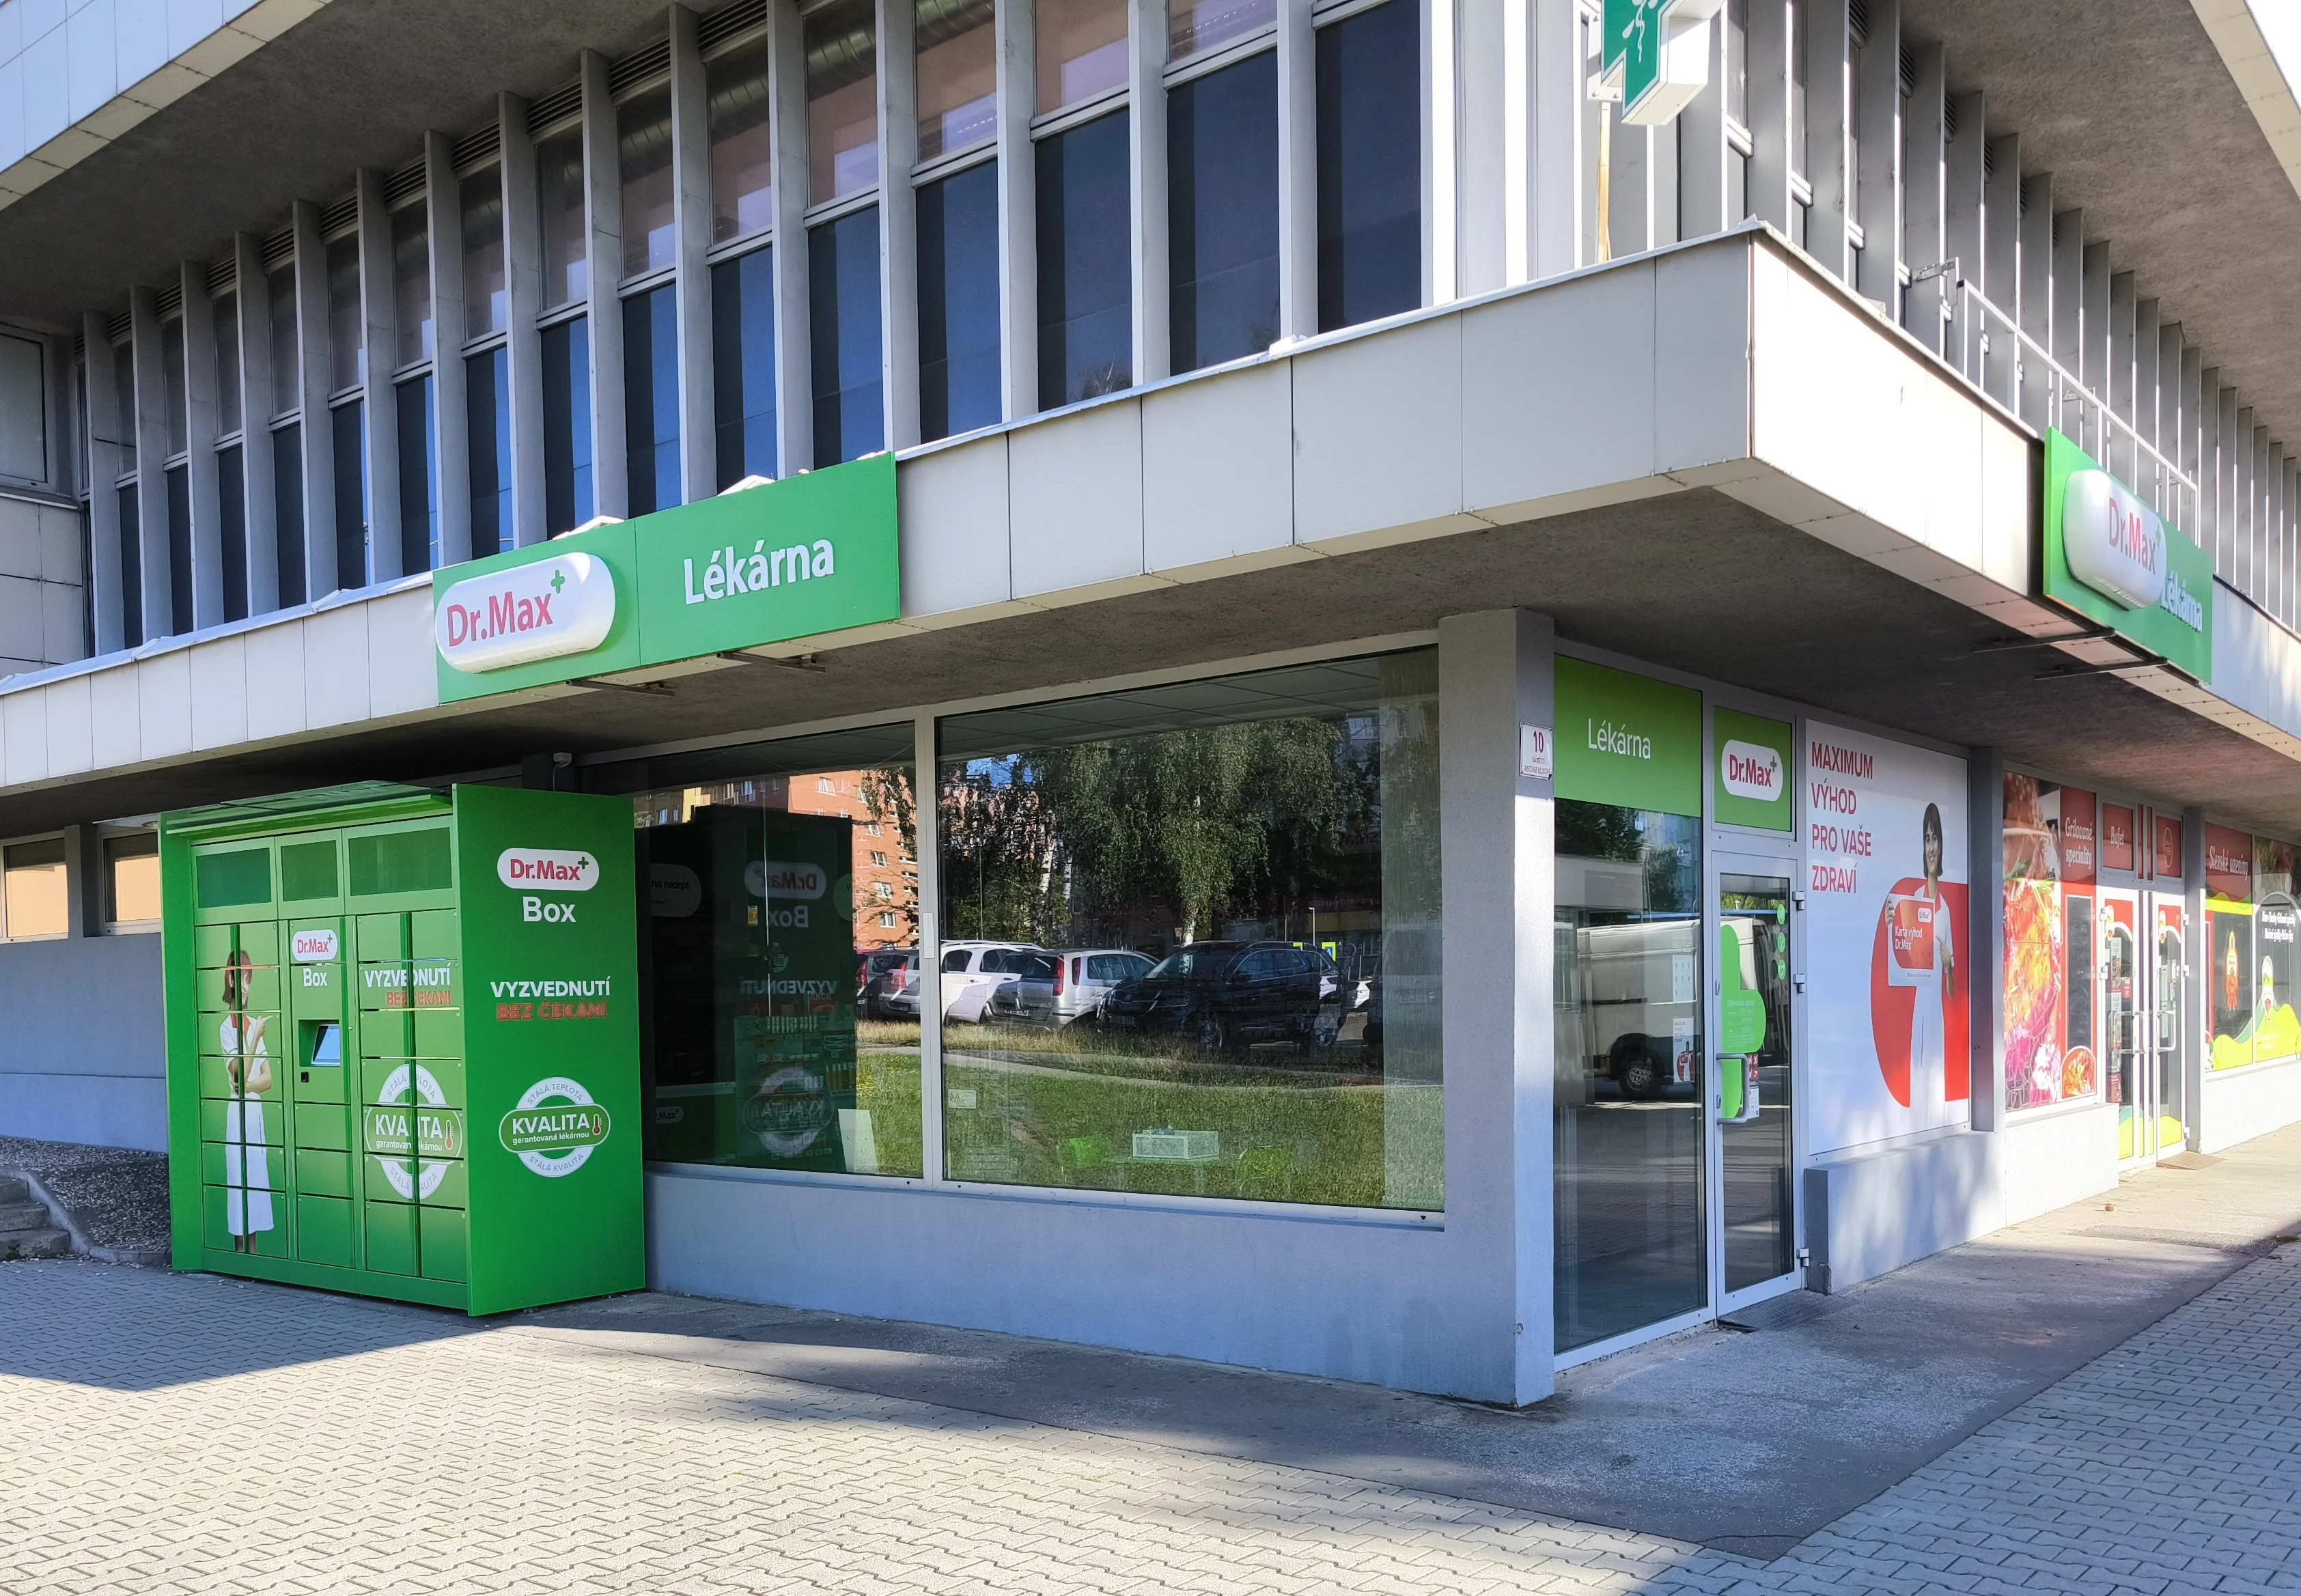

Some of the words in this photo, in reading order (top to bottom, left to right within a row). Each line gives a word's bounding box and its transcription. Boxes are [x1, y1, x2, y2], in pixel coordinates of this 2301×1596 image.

[683, 538, 835, 605] Lékárna
[2160, 570, 2203, 633] Lékárna
[1533, 730, 1544, 753] 10
[1588, 718, 1651, 759] Lékárna
[1811, 741, 1873, 780] MAXIMUM
[1811, 778, 1856, 815] VÝHOD
[1812, 824, 1838, 852] PRO
[1841, 824, 1871, 856] VAŠE
[2065, 817, 2093, 841] Grilované
[2065, 845, 2093, 869] speciality
[664, 880, 690, 891] recept
[1812, 863, 1857, 894] ZDRAVÍ
[522, 895, 576, 923] Box
[303, 968, 328, 987] Box
[490, 975, 611, 998] VYZVEDNUTÍ
[415, 986, 451, 1006] EKÁNÍ
[497, 1003, 533, 1021] BEZ
[538, 998, 607, 1020] ČEKÁNÍ
[387, 1072, 407, 1097] STÁLÁ
[527, 1084, 550, 1105] STÁLÁ
[551, 1083, 583, 1102] TEPLOTA
[376, 1114, 443, 1139] KVAITA
[512, 1112, 591, 1135] KVALITA
[376, 1140, 412, 1150] garantovan
[418, 1140, 443, 1151] kárnou
[512, 1133, 558, 1146] garantovaná
[559, 1131, 590, 1140] lékárnou
[529, 1156, 552, 1172] STÁLÁ
[553, 1153, 585, 1172] KVALITA
[390, 1166, 410, 1191] STÁLÁ
[420, 1172, 438, 1192] ALITA
